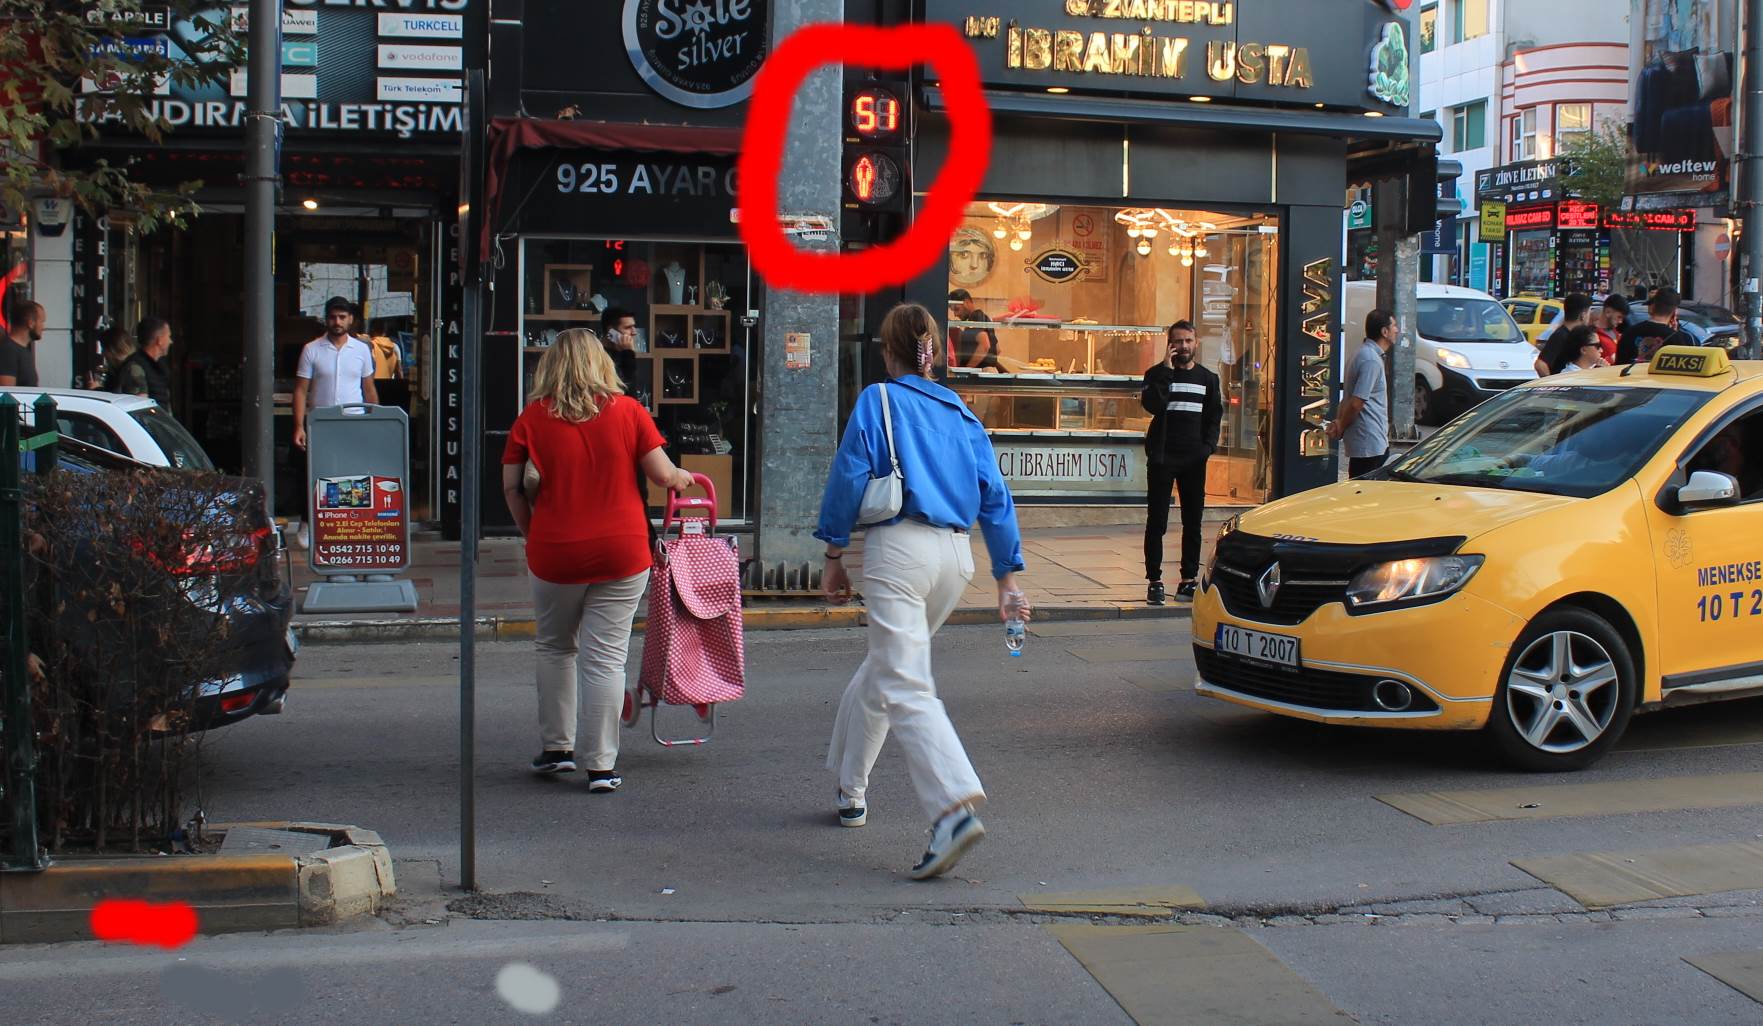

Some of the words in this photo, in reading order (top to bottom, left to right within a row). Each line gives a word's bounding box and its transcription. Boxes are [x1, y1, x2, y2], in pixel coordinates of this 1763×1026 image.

[403, 20, 461, 32] TURKCELL
[400, 52, 458, 62] vodafone
[678, 31, 748, 70] silver
[1207, 40, 1313, 89] USTA
[384, 84, 402, 93] Türk
[405, 84, 442, 94] Telekom
[856, 96, 896, 130] 51
[557, 163, 618, 194] 925
[628, 163, 716, 194] AYAR
[1659, 159, 1717, 176] weltew
[1692, 173, 1716, 182] home
[1300, 256, 1332, 457] BAKLAVA
[447, 320, 460, 504] AKSESUAR
[1088, 453, 1128, 477] USTA
[324, 511, 348, 519] iPhone
[330, 545, 353, 553] 0542
[356, 545, 372, 553] 715
[376, 545, 387, 553] 10
[330, 556, 353, 564] 0266
[356, 556, 373, 564] 715
[1697, 561, 1761, 587] MENEKŞE
[1696, 594, 1721, 623] 10
[1730, 592, 1744, 618] T
[1224, 628, 1239, 651] 10
[1244, 632, 1253, 655] T
[1259, 635, 1296, 663] 2007
